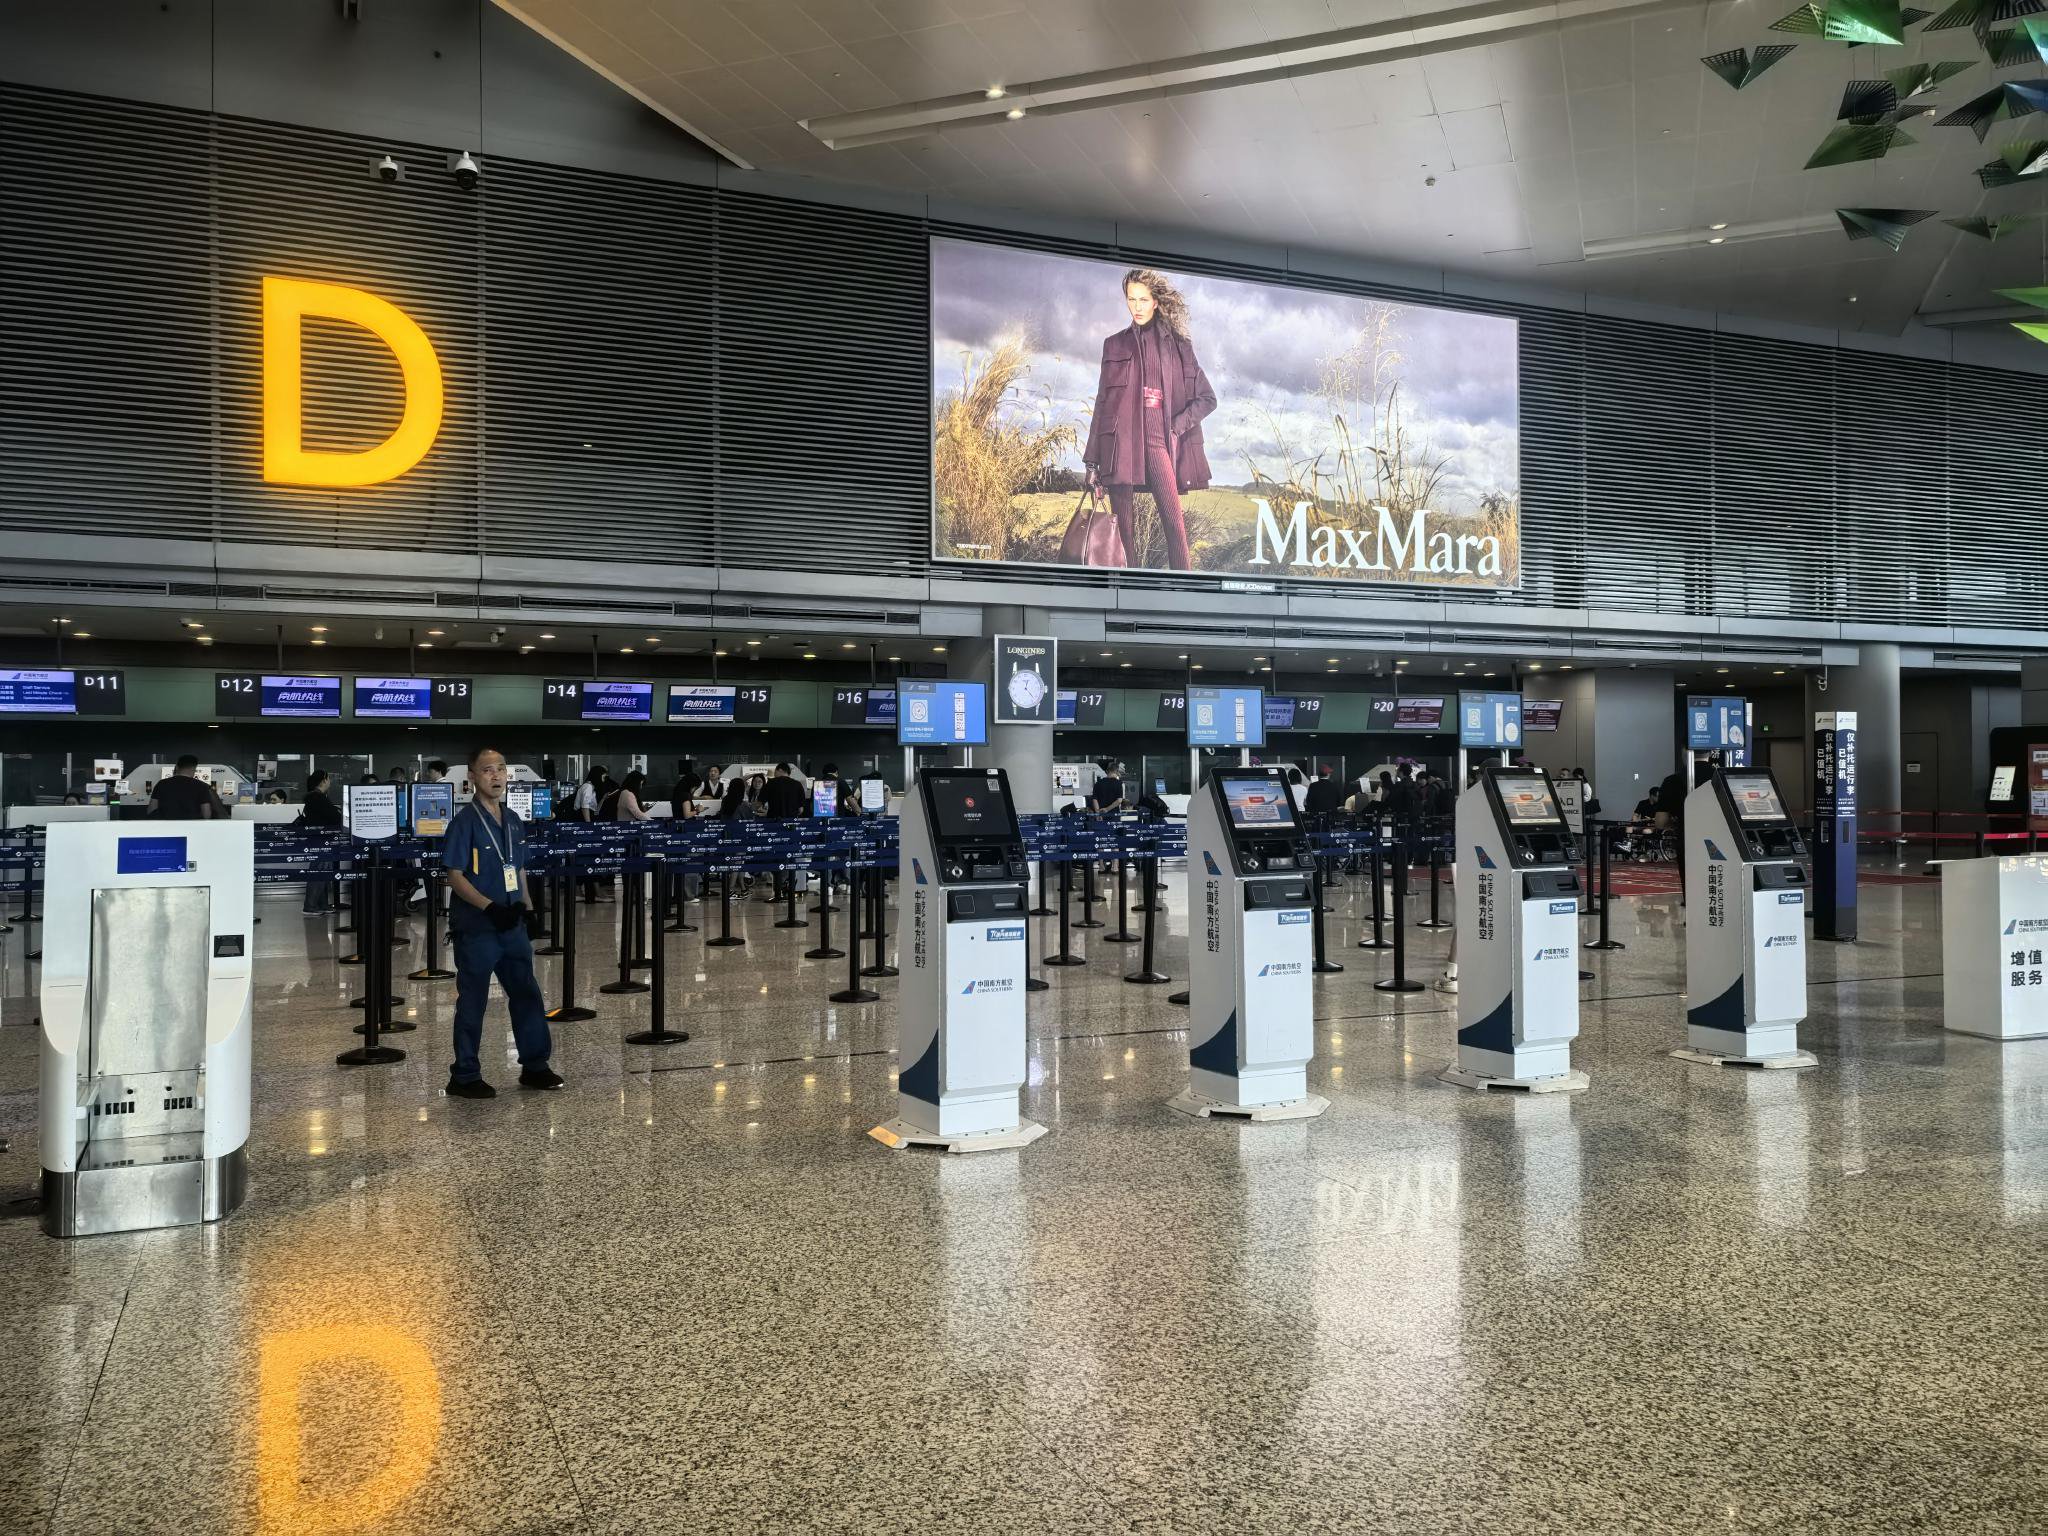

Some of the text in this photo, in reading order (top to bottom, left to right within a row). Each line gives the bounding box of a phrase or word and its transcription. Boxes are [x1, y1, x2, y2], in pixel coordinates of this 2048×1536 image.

[263, 276, 444, 487] D
[1248, 498, 1502, 576] MaxMara
[1007, 646, 1046, 655] LONGINES
[84, 676, 117, 690] D11
[221, 679, 253, 692] D12
[438, 683, 467, 696] D13
[548, 684, 576, 697] D14
[741, 690, 767, 702] D15
[837, 692, 862, 704] D16
[1081, 694, 1102, 706] D17
[1164, 697, 1184, 709] D18
[1300, 700, 1320, 711] D19
[1374, 701, 1394, 712] D20
[1816, 748, 1825, 779] 已值机
[1825, 733, 1834, 795] 仅补托运行李
[1838, 748, 1847, 780] 已值机
[1846, 732, 1855, 795] 仅补托运行李
[1708, 864, 1717, 927] 中国南方航空
[1478, 873, 1487, 940] 中国南方航空
[1207, 880, 1215, 952] 中国南方航空
[914, 889, 922, 968] 中国南方航空
[1543, 947, 1569, 955] 中国南方航空
[2010, 949, 2043, 966] 增值
[1271, 962, 1302, 971] 中国南方航空
[977, 978, 1013, 988] 中国南方航空
[2010, 970, 2043, 987] 服务
